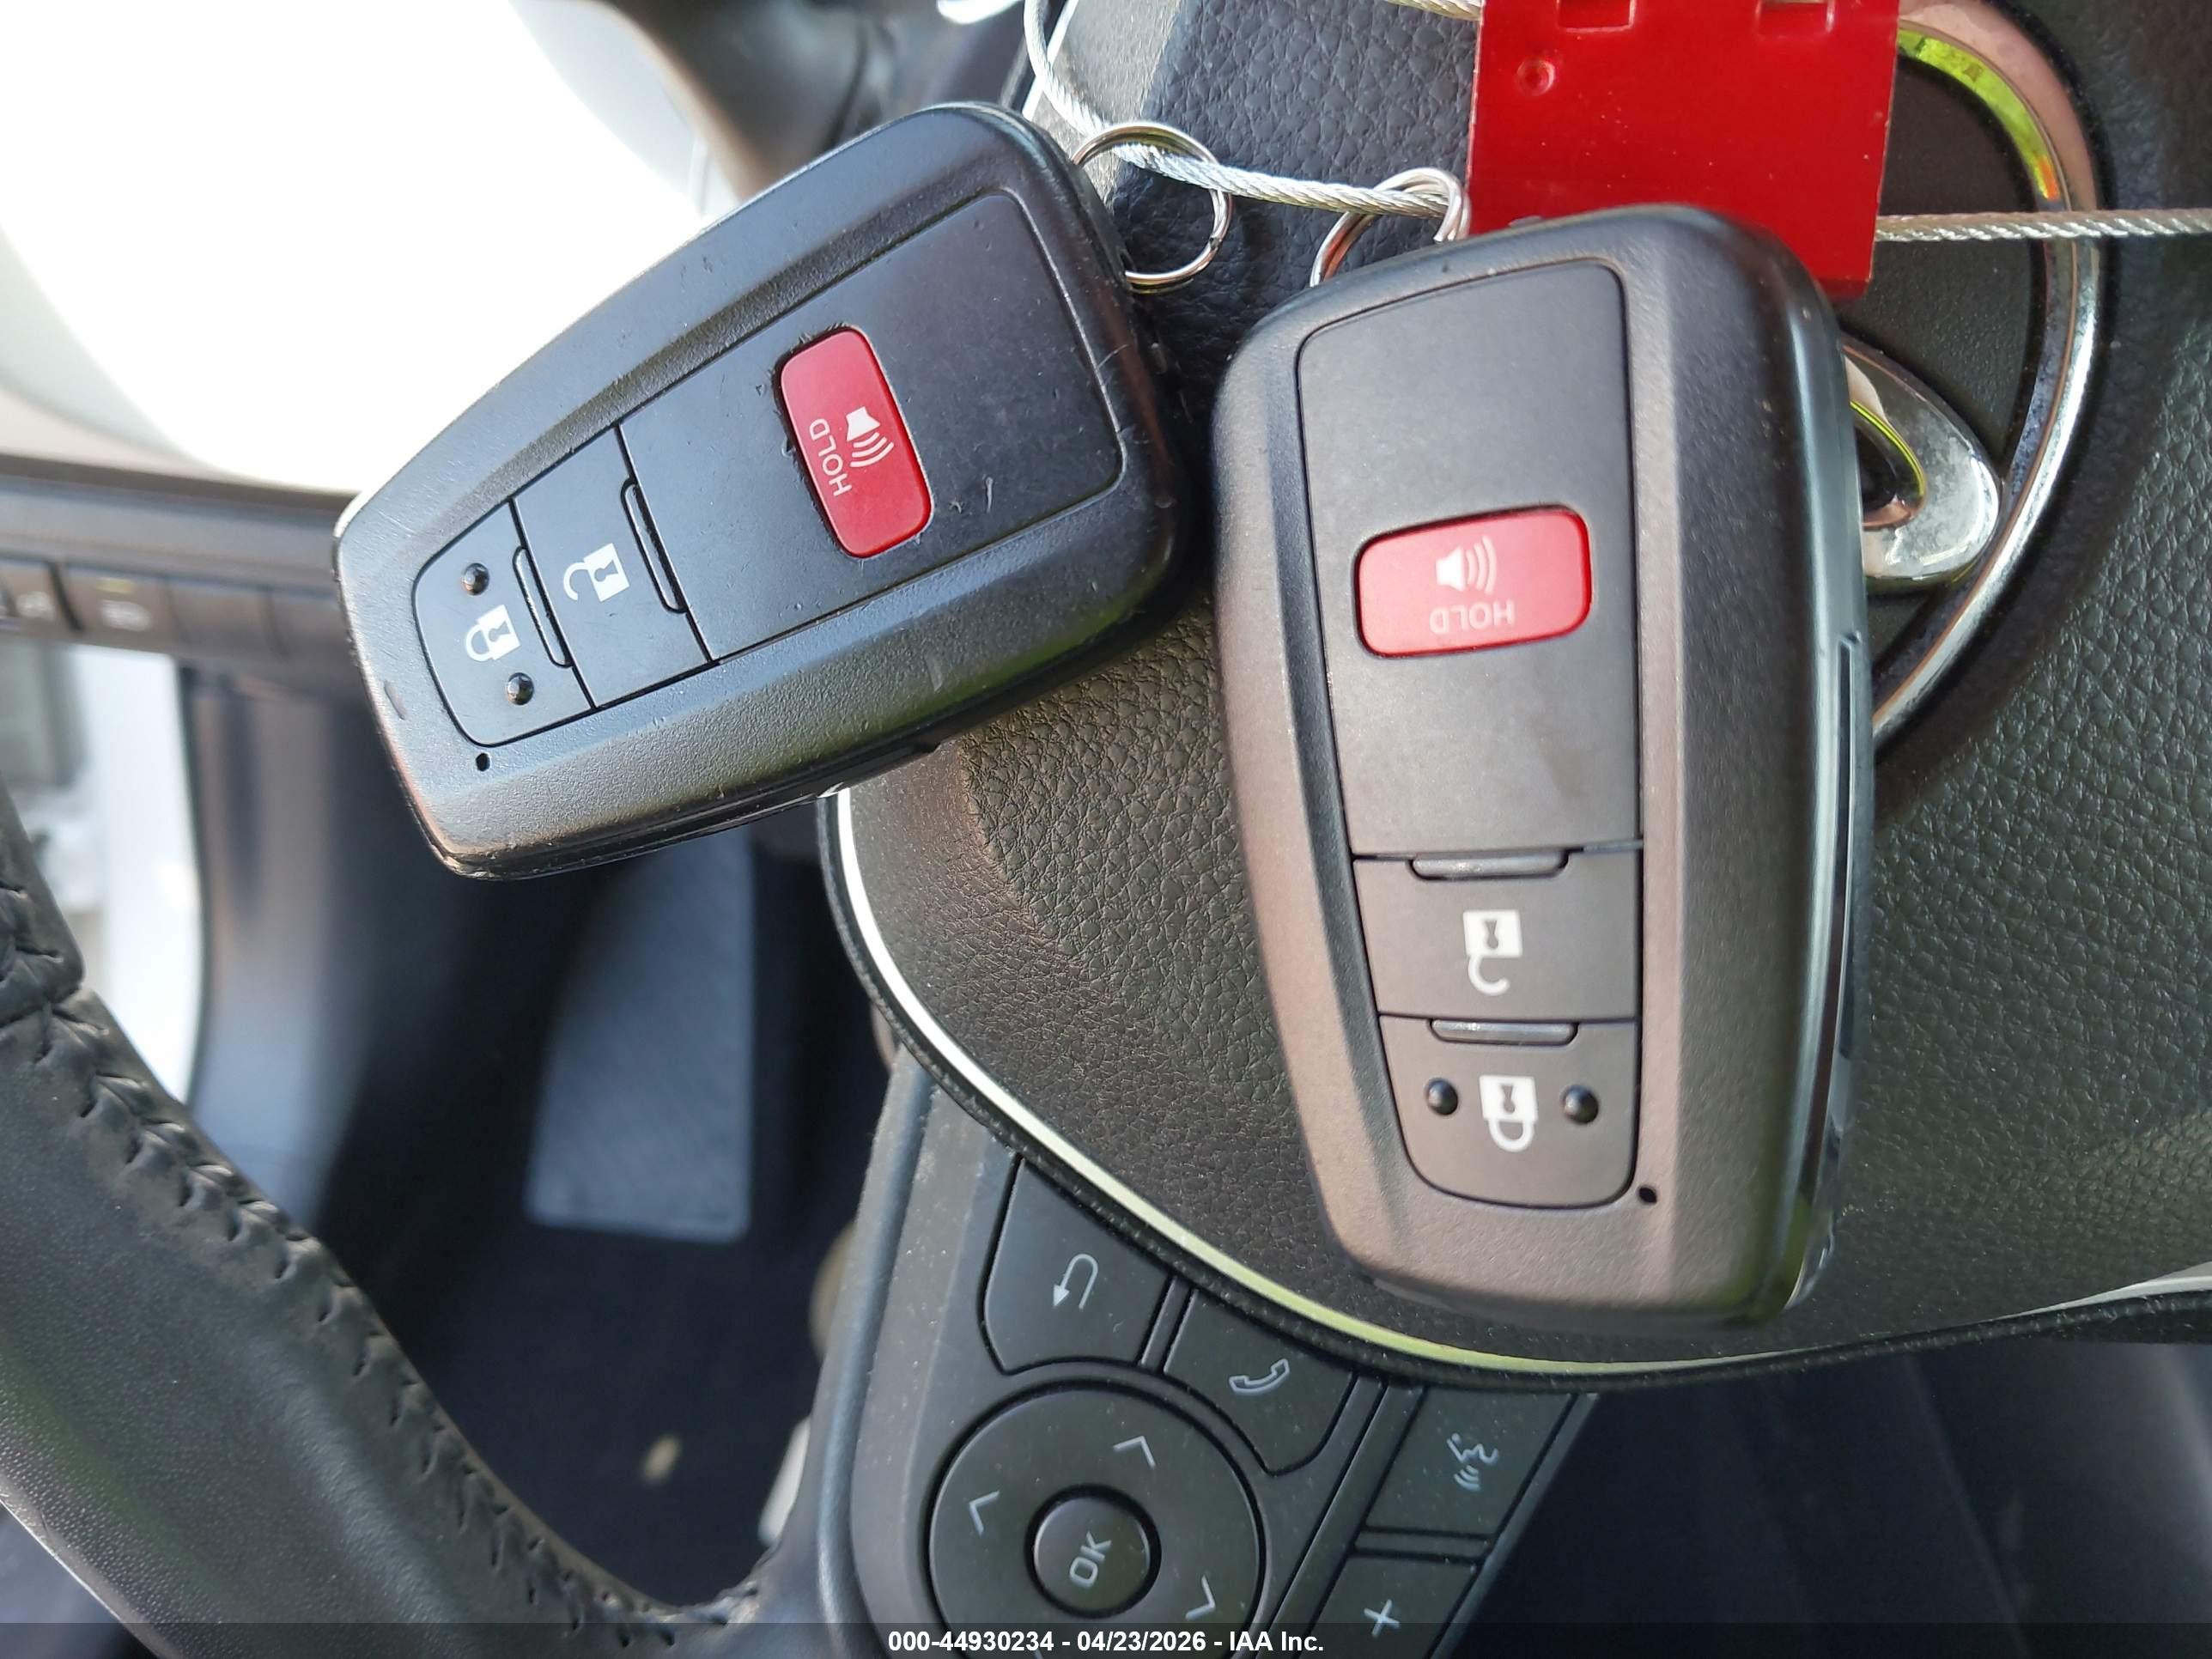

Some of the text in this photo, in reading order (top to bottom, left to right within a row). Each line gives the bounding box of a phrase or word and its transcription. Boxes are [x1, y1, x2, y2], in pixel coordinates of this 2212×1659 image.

[809, 418, 852, 497] HOLD
[1429, 599, 1515, 635] HOLD
[1069, 1531, 1112, 1588] OK
